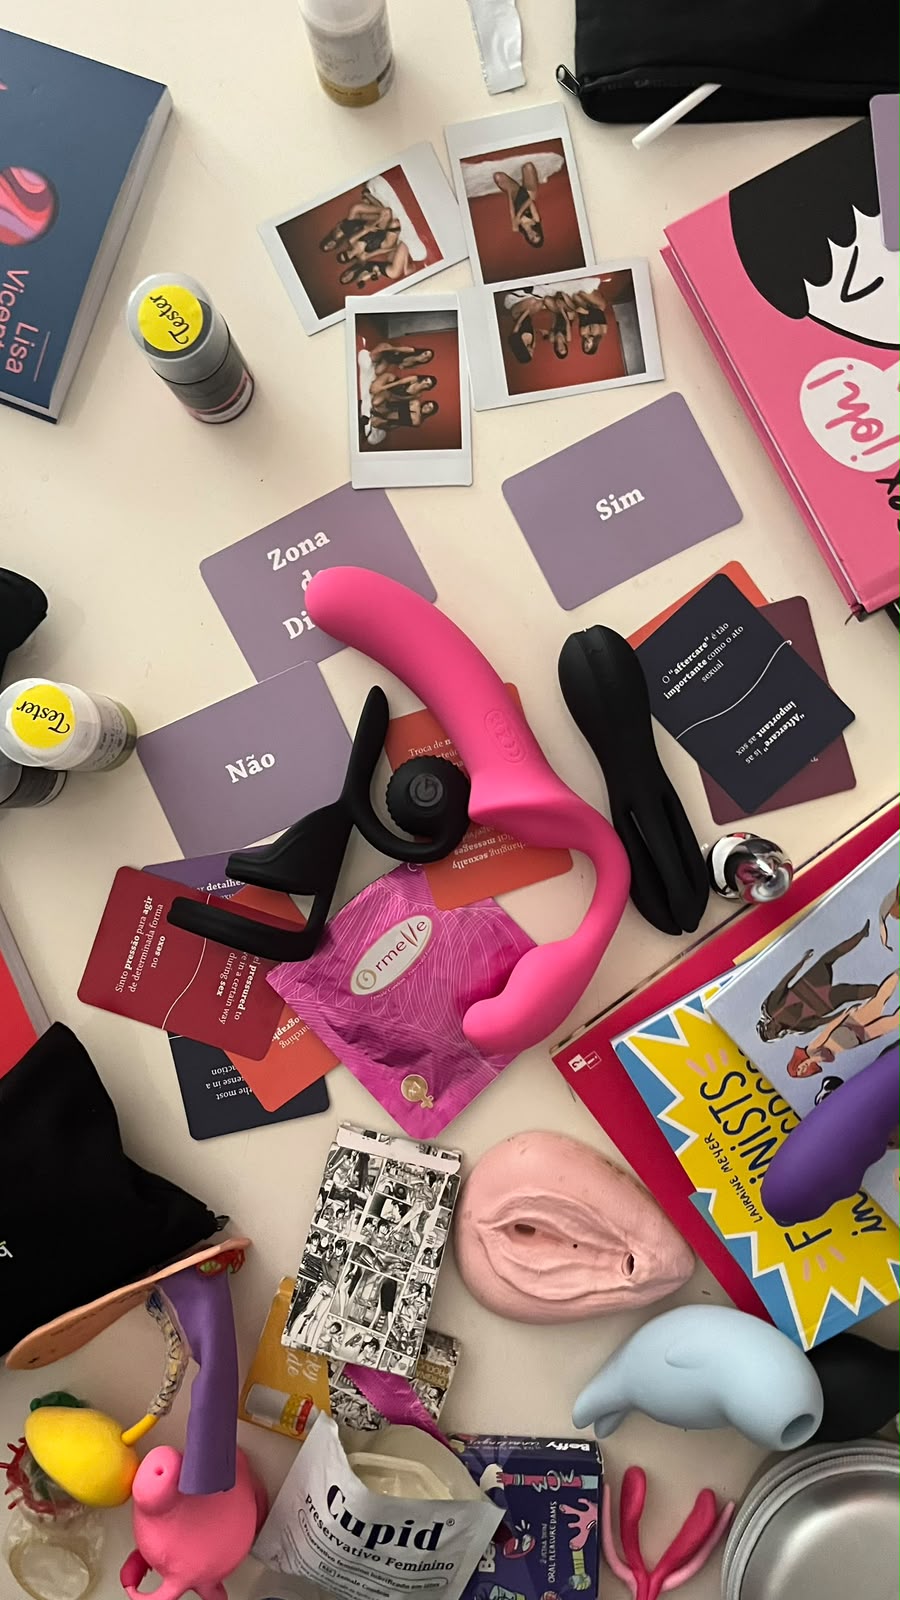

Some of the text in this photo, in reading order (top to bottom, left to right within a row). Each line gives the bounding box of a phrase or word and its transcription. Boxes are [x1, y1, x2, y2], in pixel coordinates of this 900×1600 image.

[150, 295, 190, 345] Tester
[5, 322, 39, 374] Lisa
[596, 489, 645, 520] Sim
[267, 531, 330, 571] Zona
[301, 570, 314, 593] d
[661, 673, 672, 686] O
[716, 623, 729, 635] tão
[663, 659, 708, 699] importante
[707, 642, 726, 661] como
[732, 626, 744, 638] ato
[701, 659, 724, 682] sexual
[16, 700, 71, 734] Tester
[736, 701, 797, 756] important as sex
[408, 745, 432, 757] Troca
[433, 740, 443, 749] de
[745, 755, 754, 764] as
[753, 748, 763, 756] is
[225, 753, 276, 783] Não
[452, 853, 488, 870] sexually
[454, 838, 496, 855] messages
[115, 896, 153, 993] Sinto pressão para agir
[128, 904, 163, 993] de determinada forma
[151, 936, 166, 968] no sexo
[356, 921, 427, 990] Ormelle
[216, 952, 237, 996] during sex
[238, 961, 245, 970] in
[225, 978, 239, 1007] certain
[237, 964, 257, 1010] pressured
[218, 1008, 230, 1025] way
[234, 1011, 242, 1020] to
[279, 1025, 310, 1049] atching
[216, 1090, 237, 1100] most
[704, 1132, 734, 1173] MEYER
[532, 1468, 574, 1493] WOW
[305, 1493, 454, 1572] Preservativo Feminino
[548, 1562, 556, 1583] ORAL
